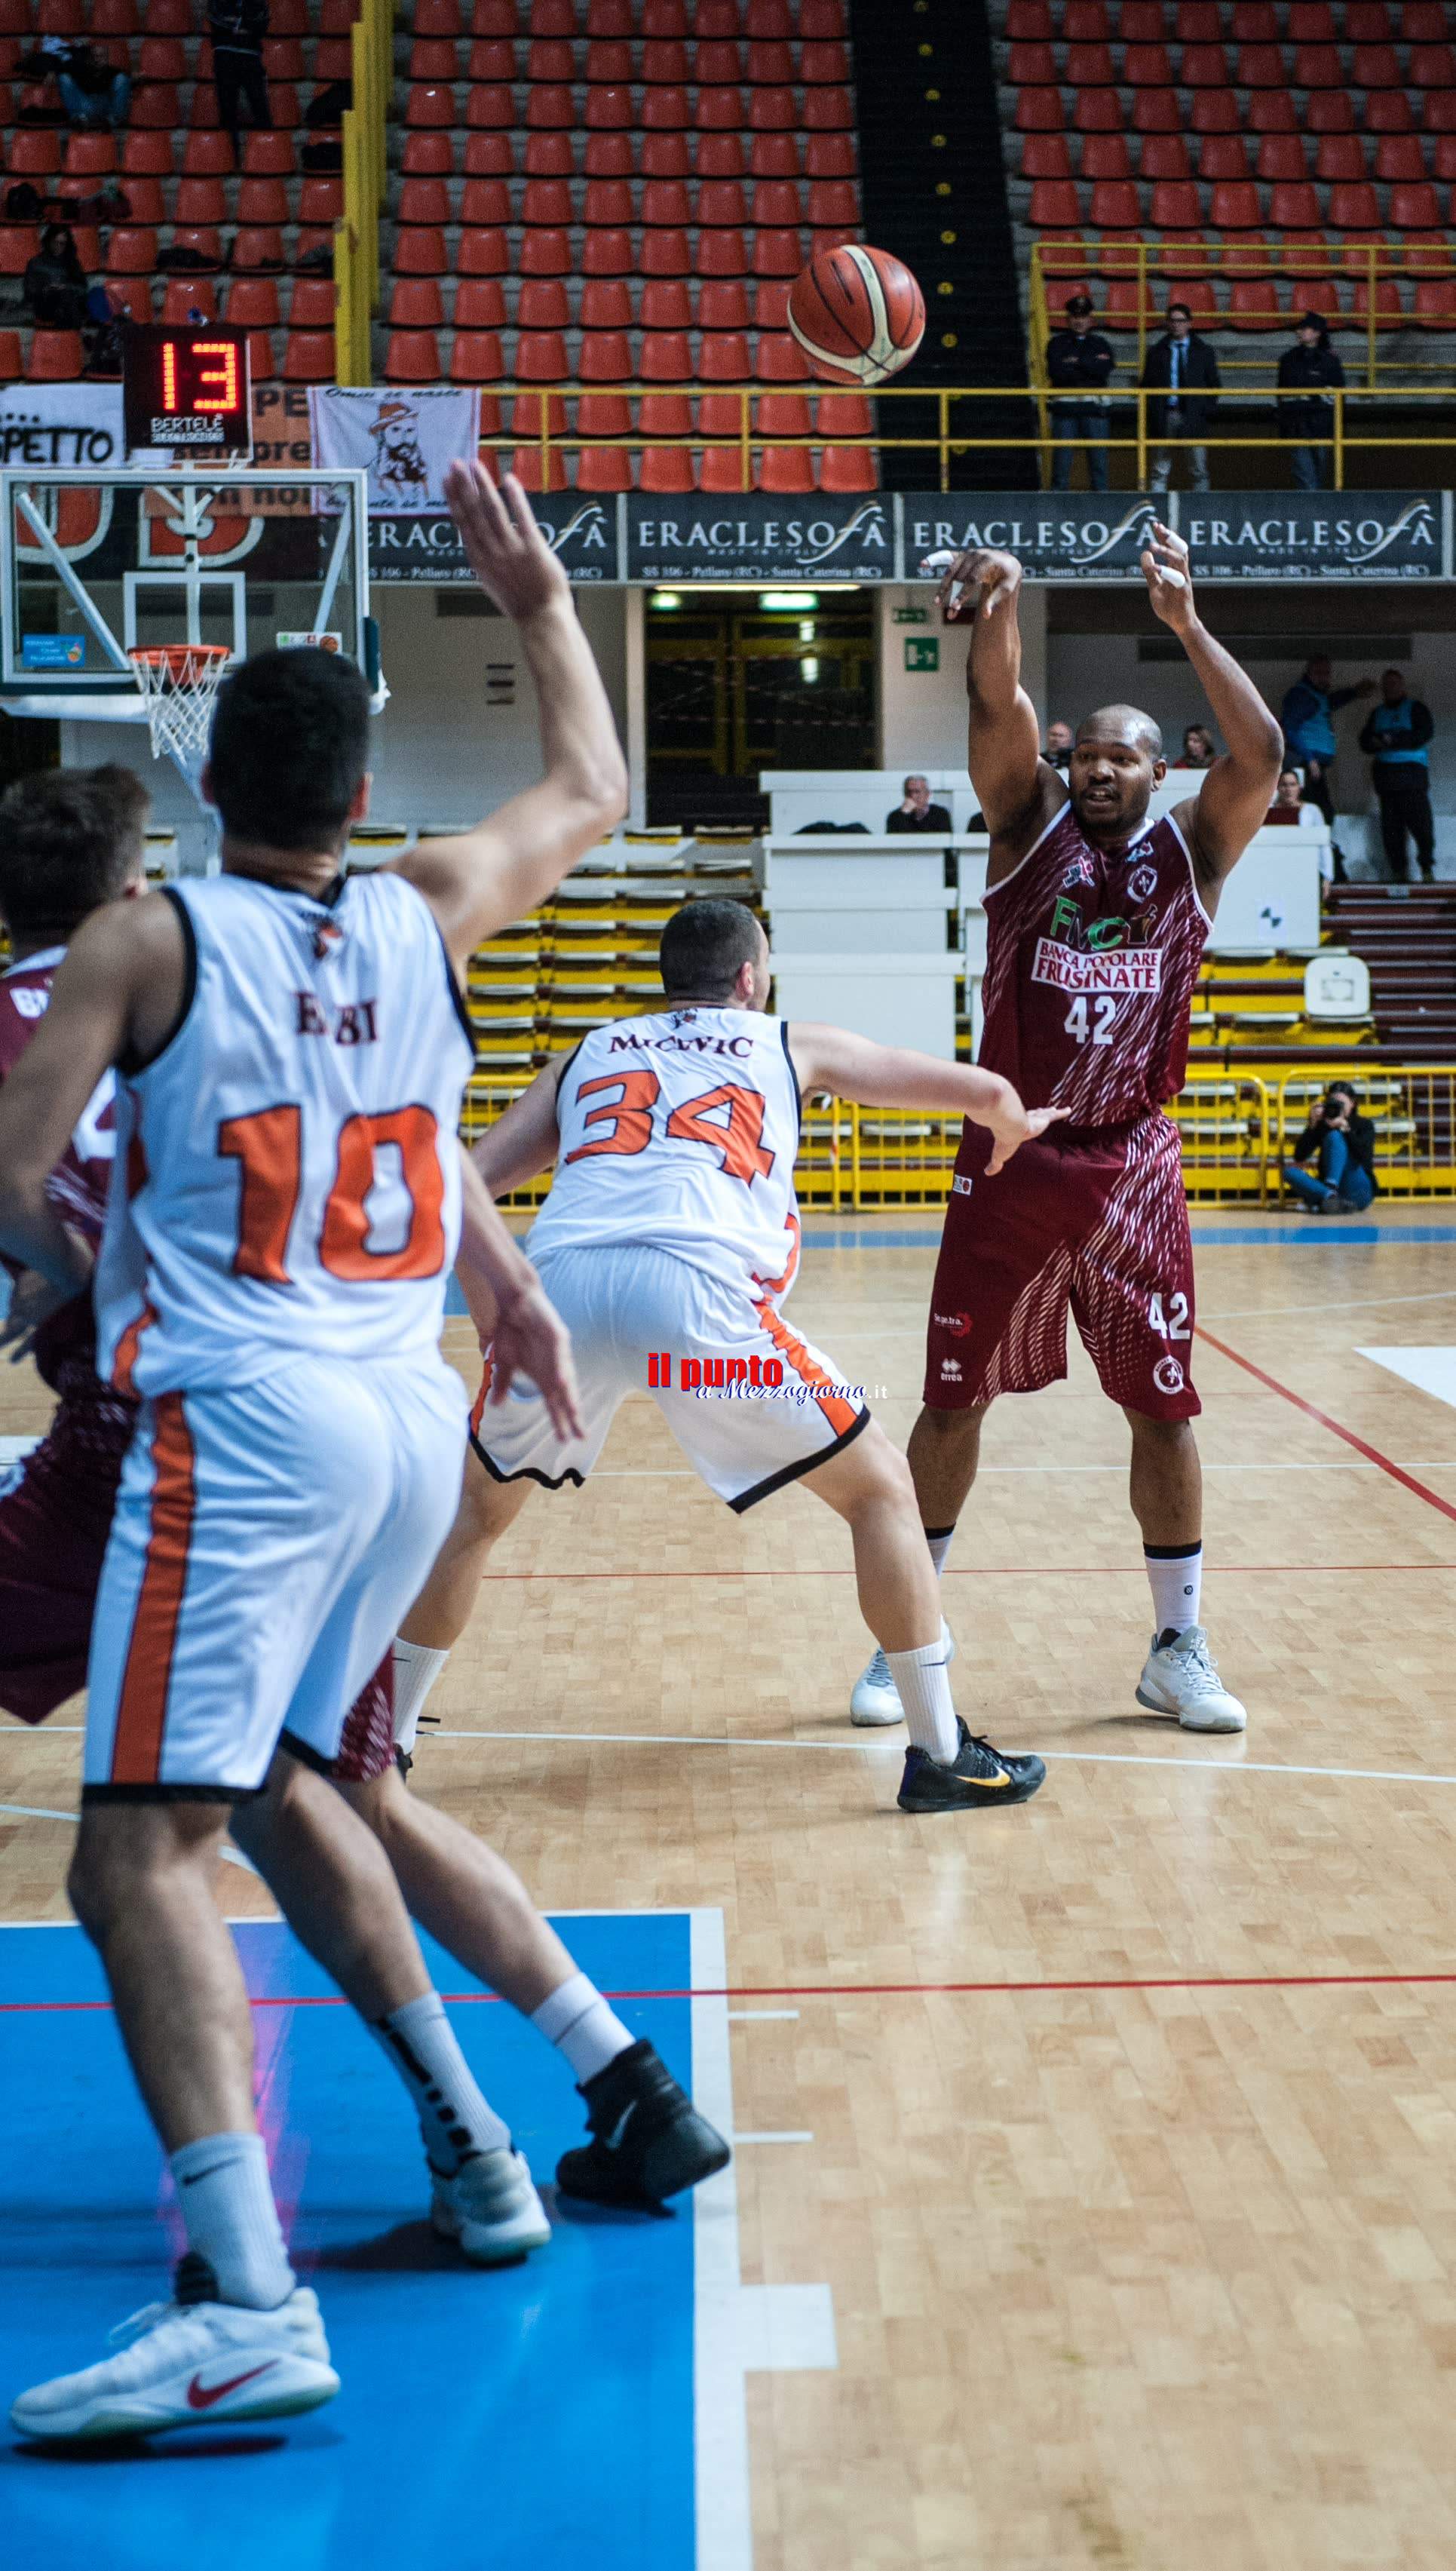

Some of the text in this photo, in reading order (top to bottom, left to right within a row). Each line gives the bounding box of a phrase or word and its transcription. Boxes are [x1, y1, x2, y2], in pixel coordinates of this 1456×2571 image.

[163, 342, 236, 410] 13
[0, 425, 113, 464] PETTO
[1036, 958, 1157, 989] FRUSINATE
[1041, 943, 1158, 969] BANCA POPOLARE
[1064, 996, 1116, 1045] 42
[564, 1069, 776, 1189] 34
[217, 1103, 445, 1284] 10
[1148, 1291, 1191, 1340] 42
